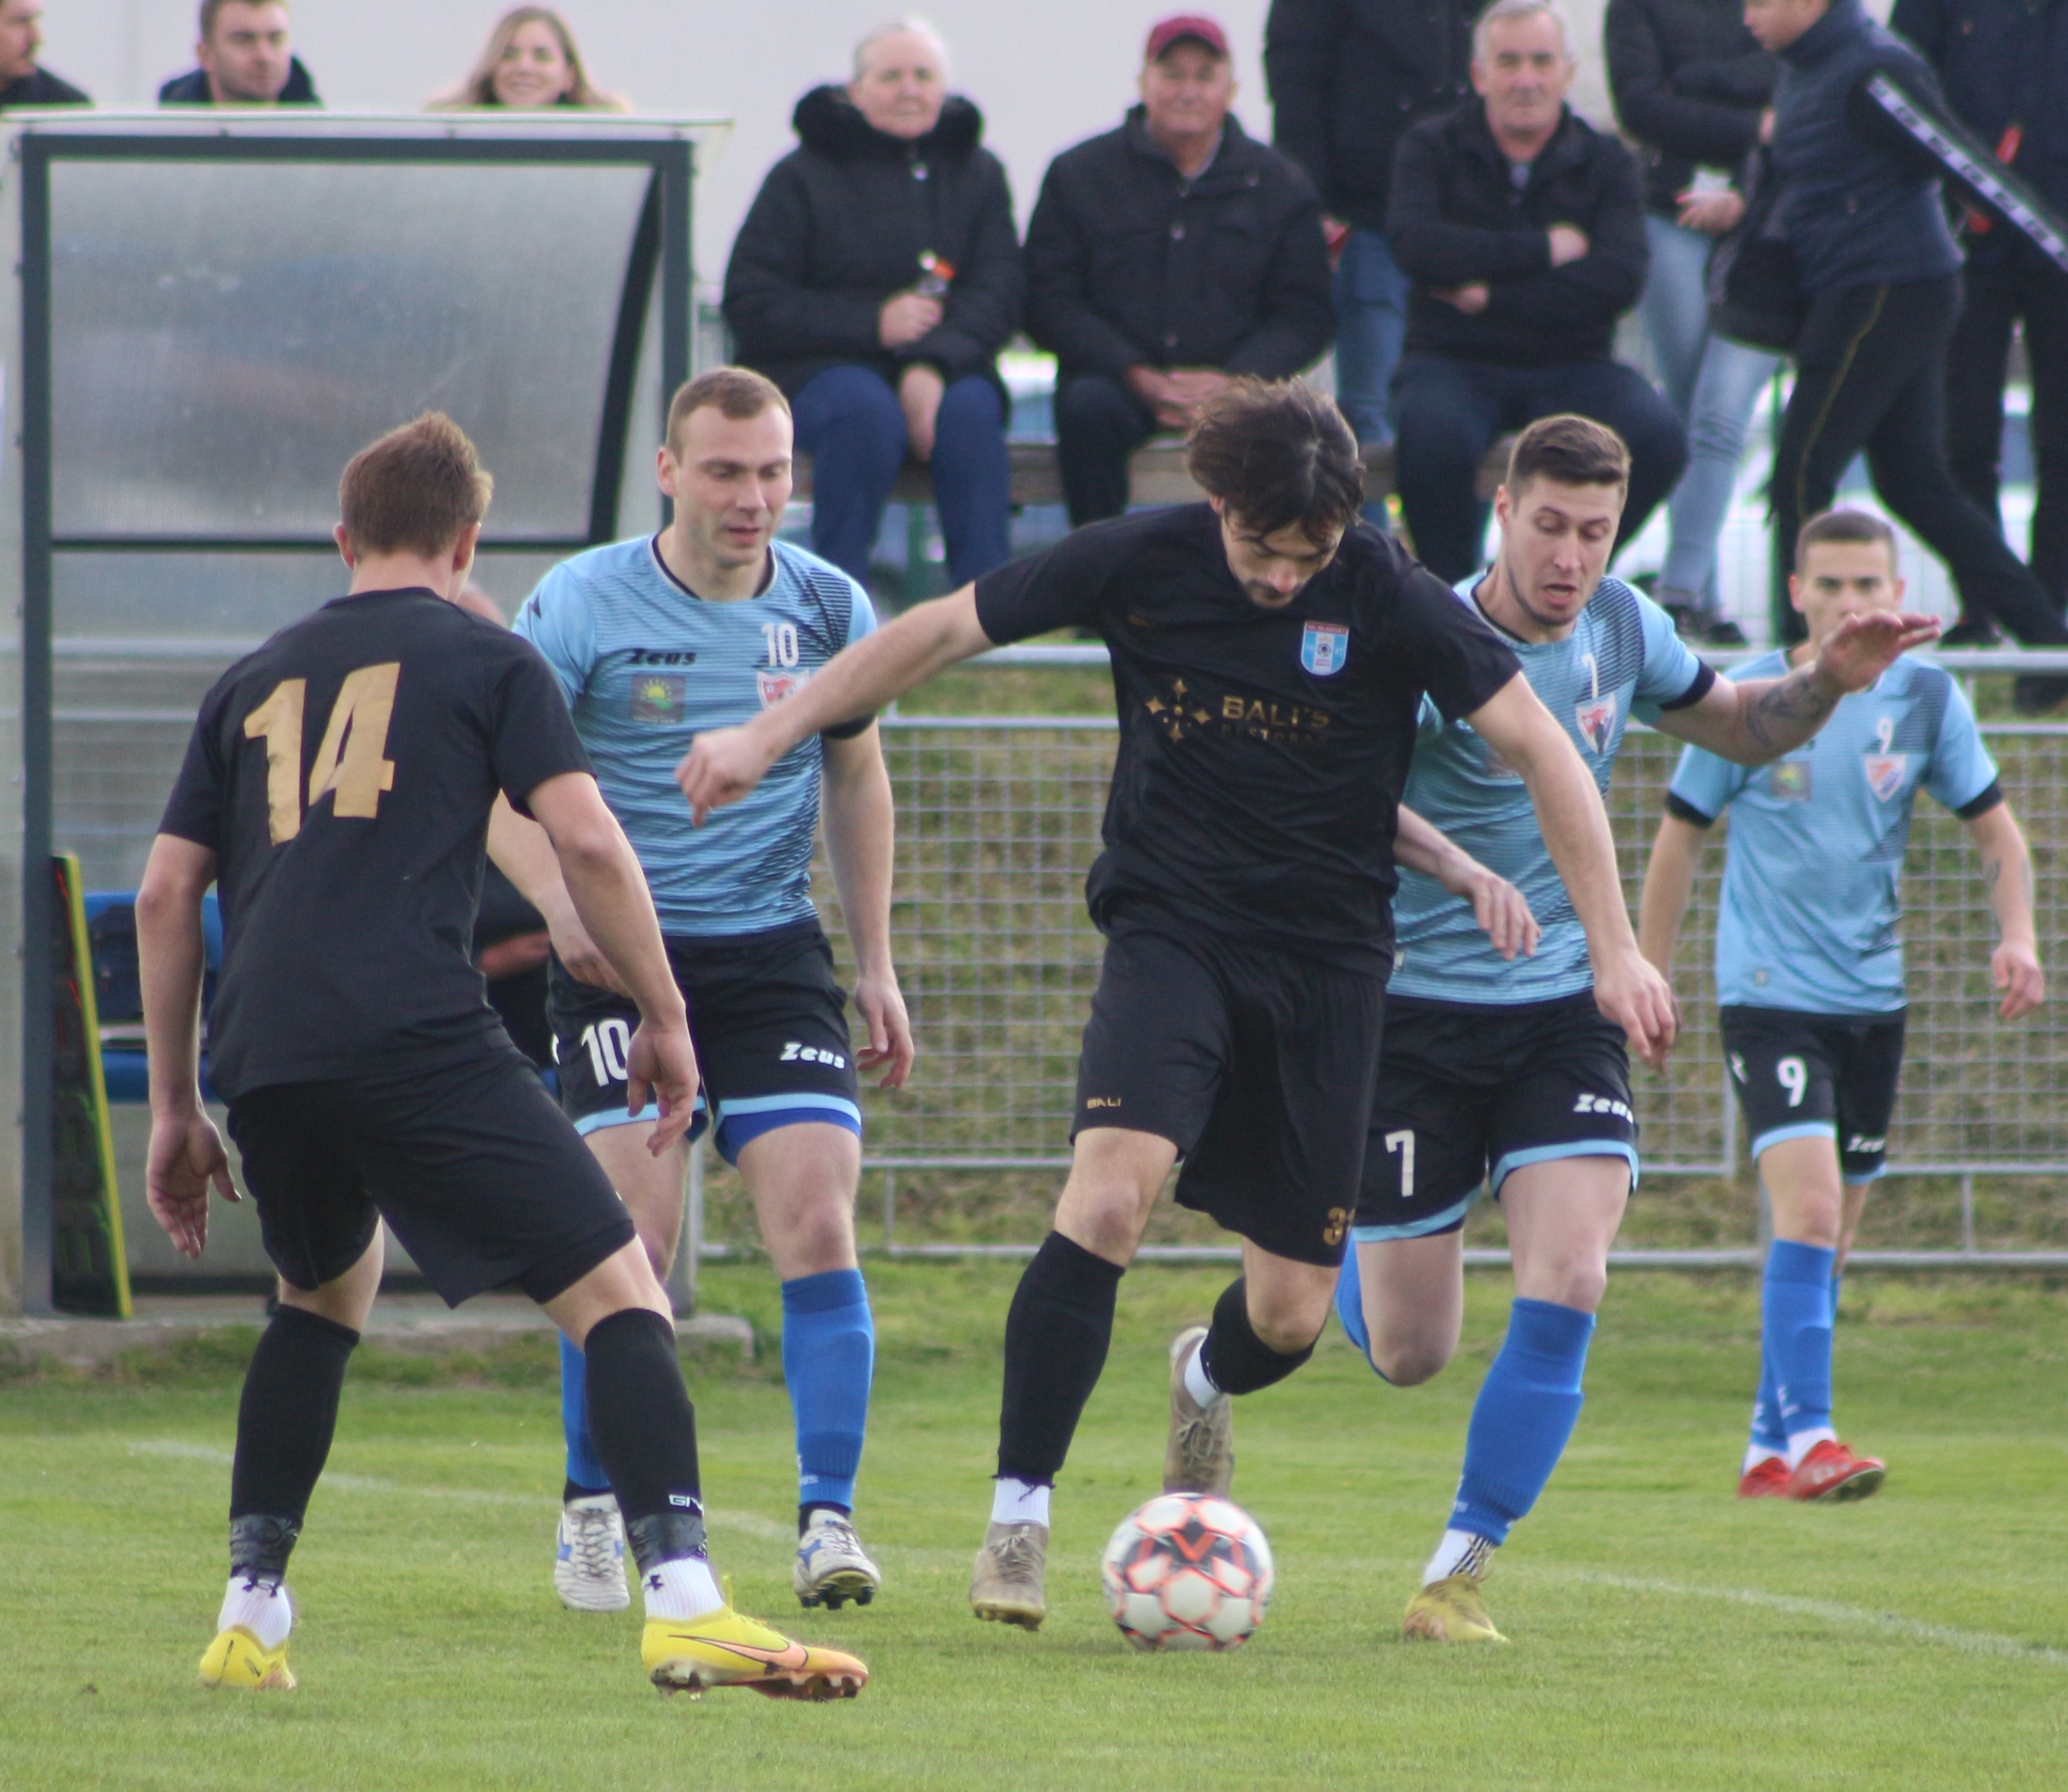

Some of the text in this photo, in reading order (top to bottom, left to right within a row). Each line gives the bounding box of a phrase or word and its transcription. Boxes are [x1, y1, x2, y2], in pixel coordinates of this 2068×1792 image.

[761, 623, 799, 668] 10
[244, 662, 400, 846] 14
[1877, 718, 1893, 754] 9
[582, 1018, 630, 1087] 10
[780, 1041, 845, 1069] Zeus
[1087, 1097, 1123, 1109] BALI
[1777, 1056, 1807, 1107] 9
[1385, 1129, 1415, 1197] 7
[668, 1493, 704, 1517] GIV
